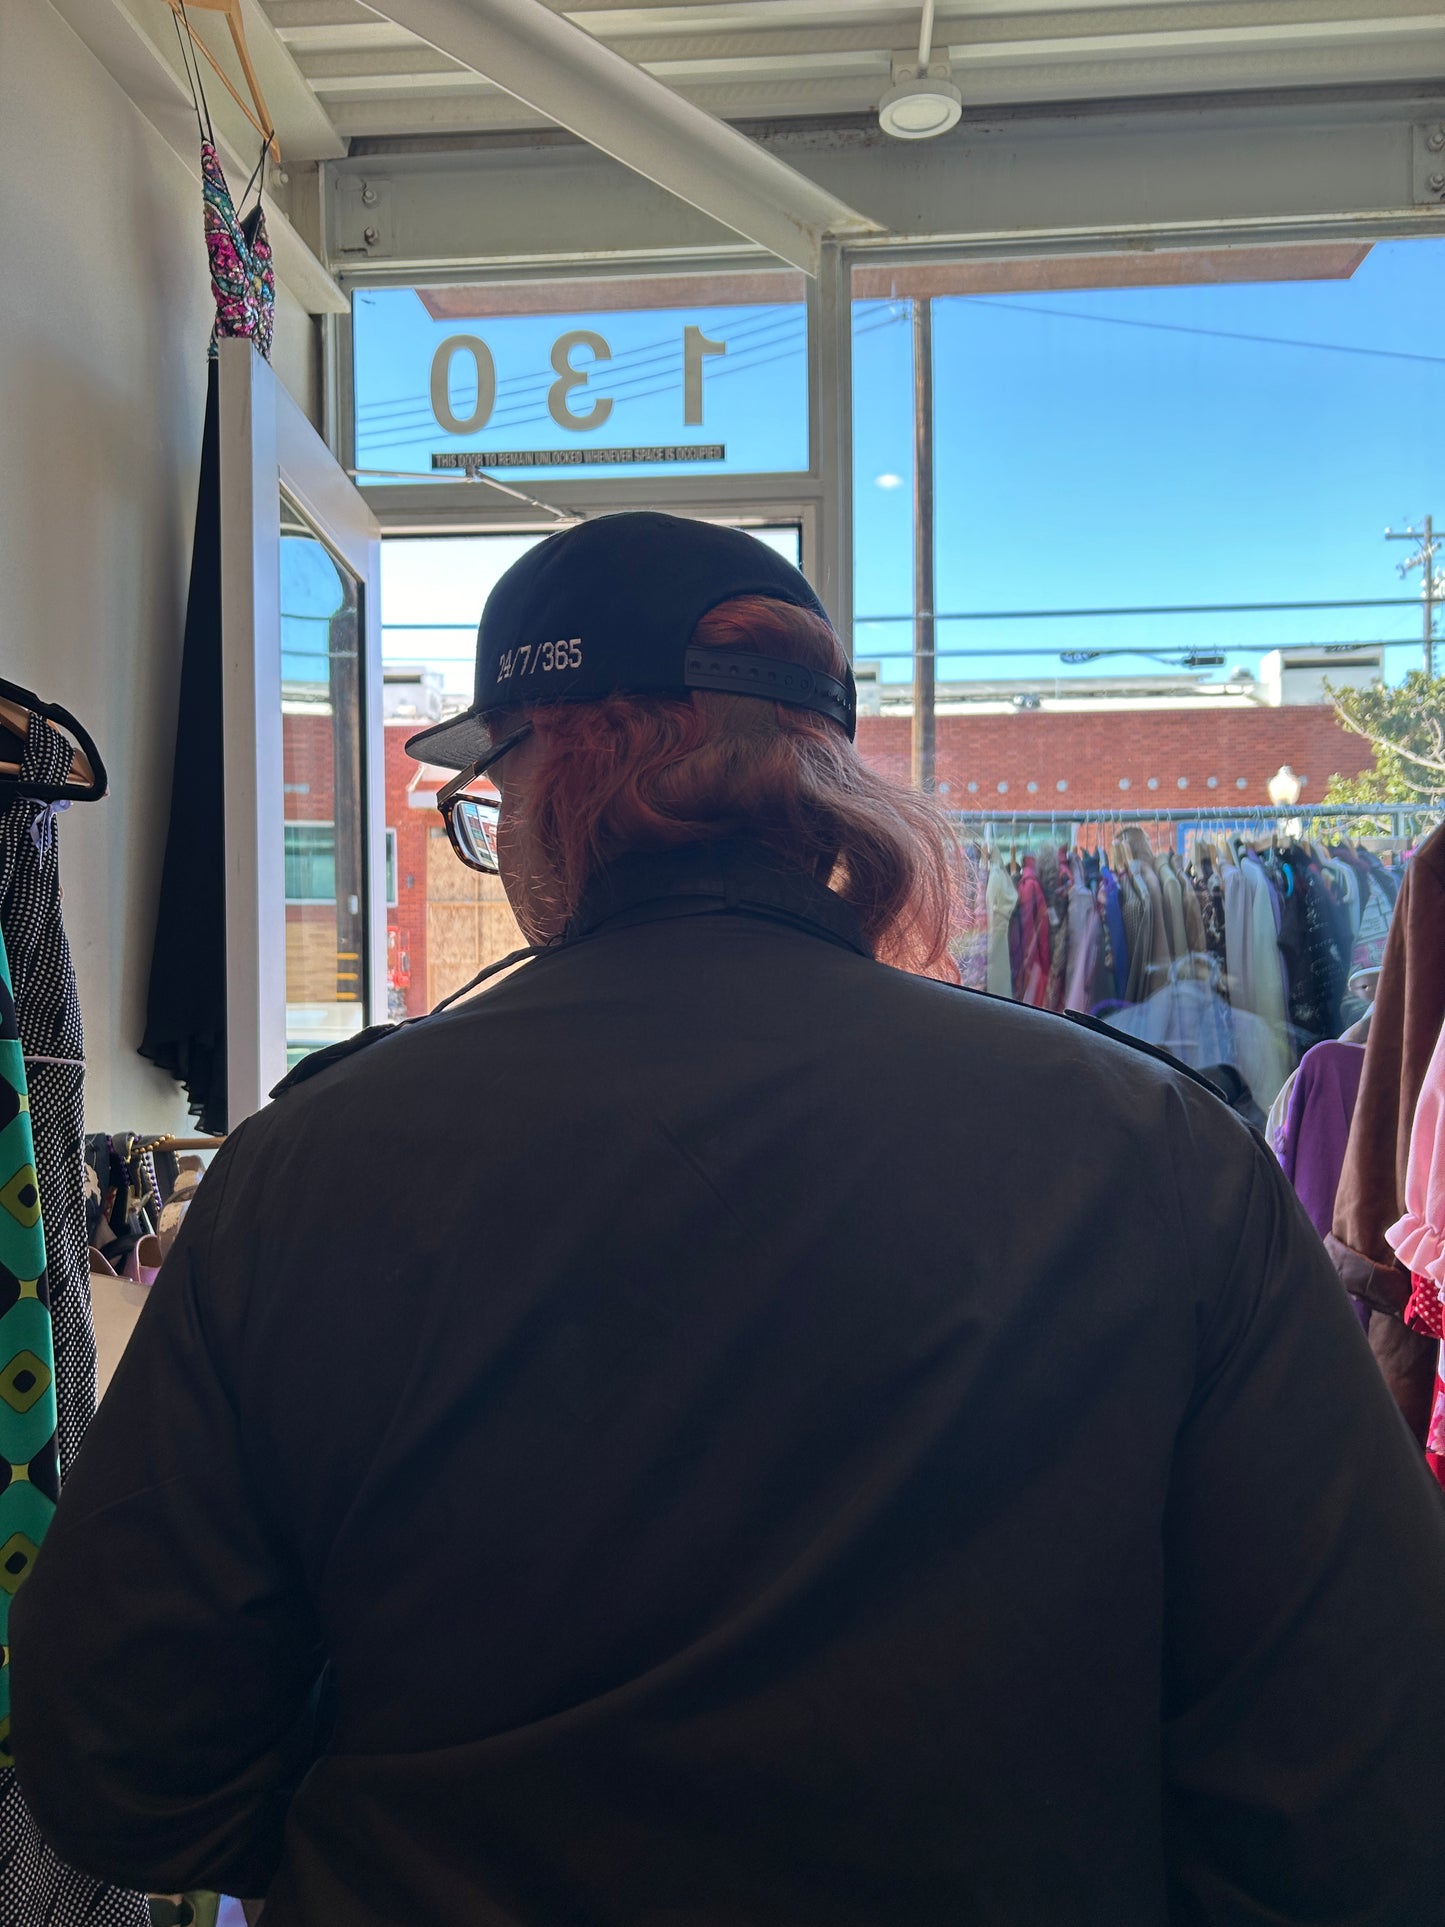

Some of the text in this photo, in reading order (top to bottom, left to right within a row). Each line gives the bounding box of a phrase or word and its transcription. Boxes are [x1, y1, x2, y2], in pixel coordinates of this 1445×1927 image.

[436, 446, 722, 468] THIS DOOR TO REMAIN UNLOCKED WHENEVER SPACE IS OCCUPIED
[496, 638, 583, 683] 24/7/365
